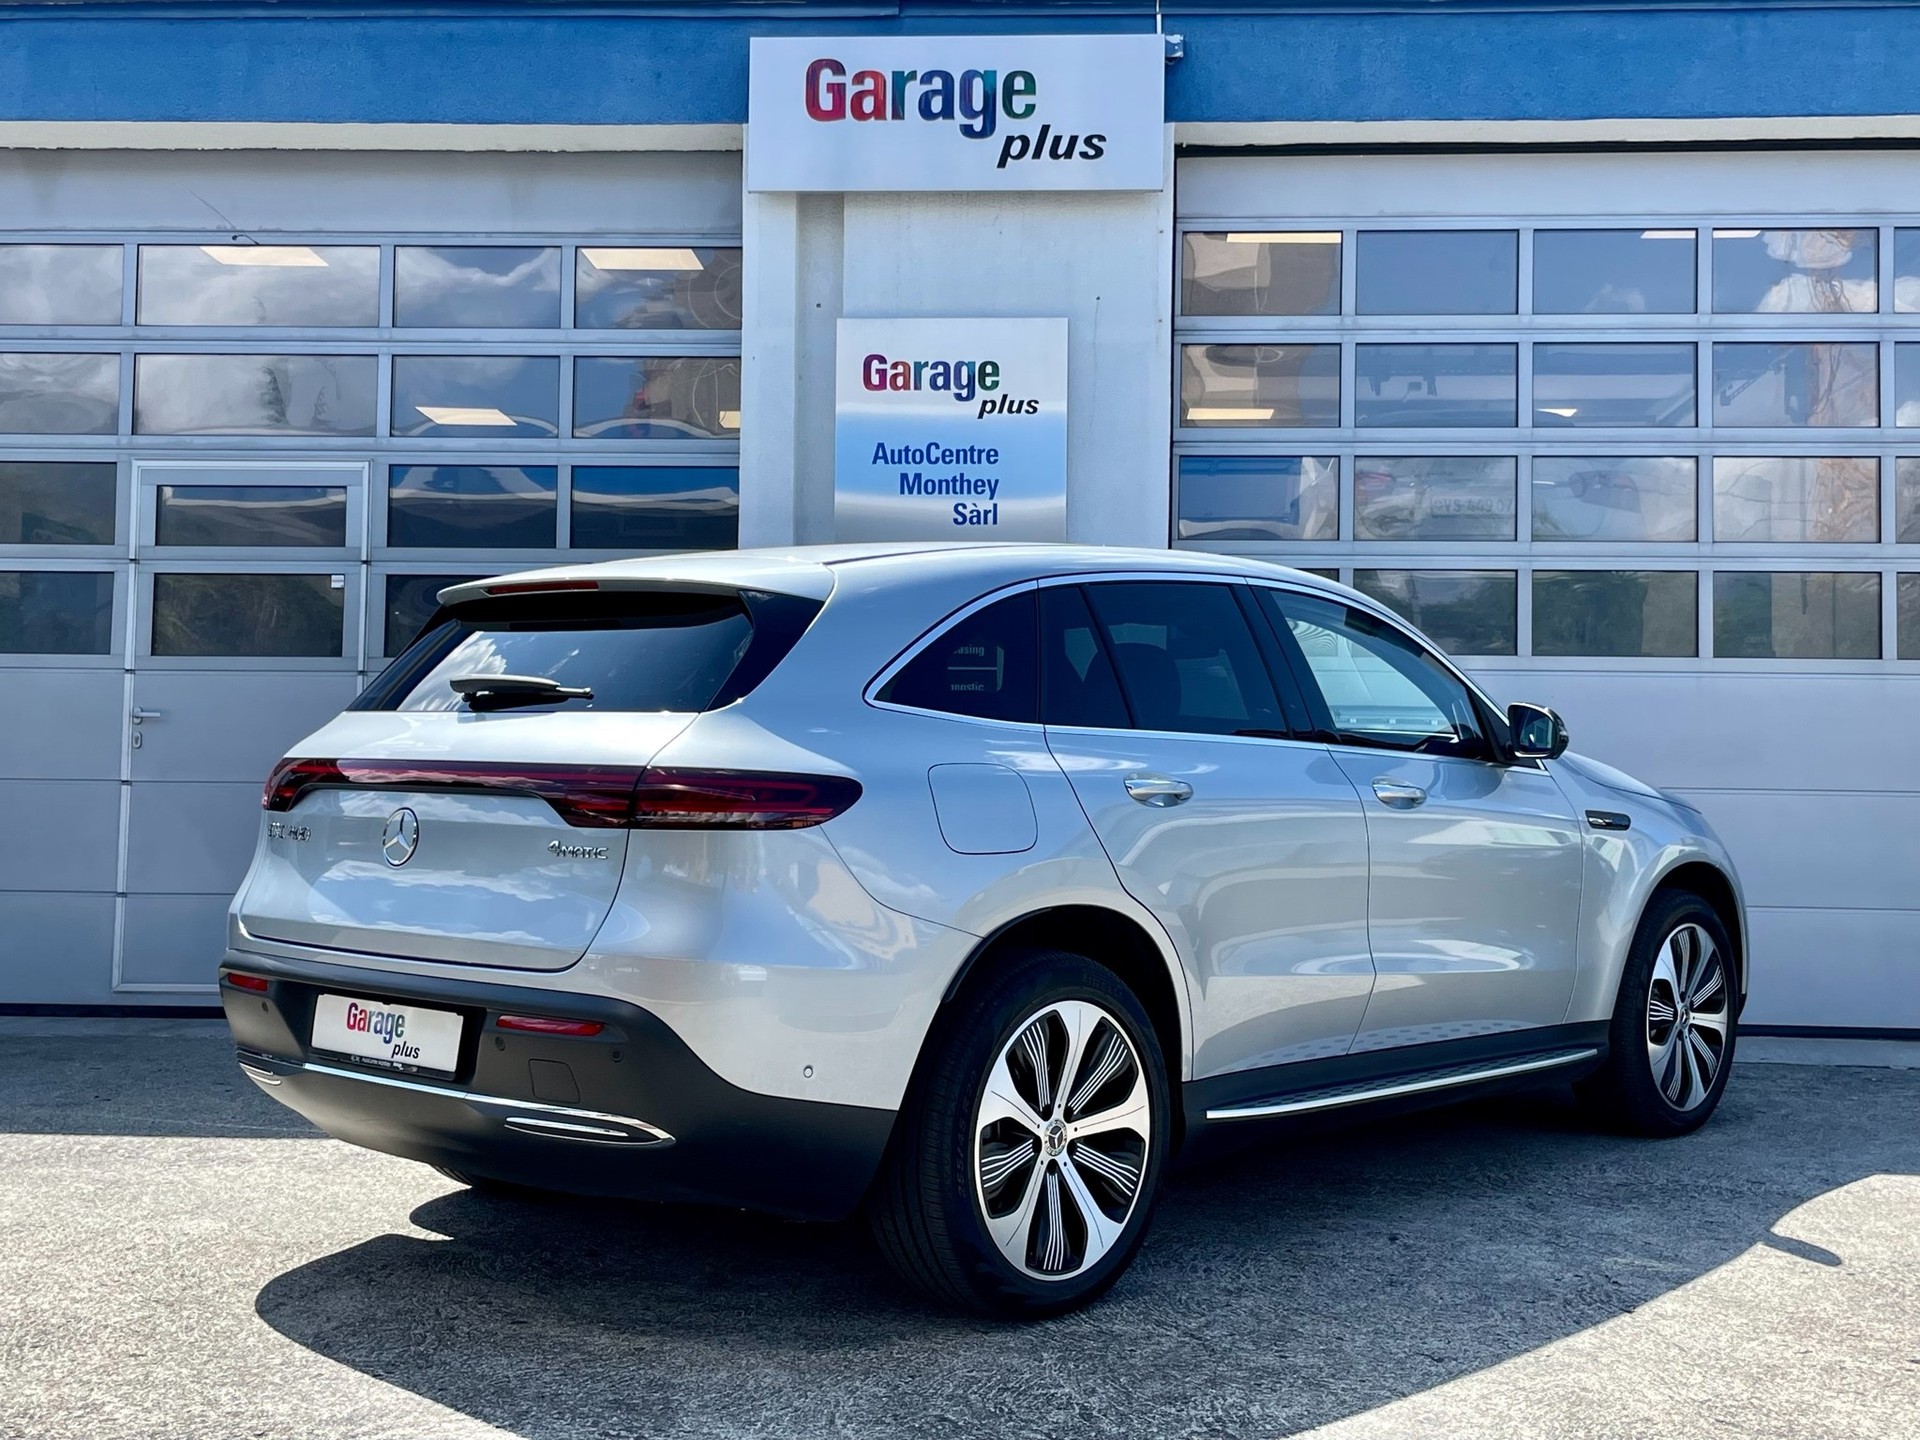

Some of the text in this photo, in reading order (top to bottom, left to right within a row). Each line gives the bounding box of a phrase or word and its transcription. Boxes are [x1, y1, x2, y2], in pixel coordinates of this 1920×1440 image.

[805, 58, 1037, 139] Garage
[996, 124, 1107, 169] plus
[862, 354, 1000, 402] Garage
[977, 394, 1040, 419] plus
[871, 442, 999, 465] AutoCentre
[899, 472, 1000, 501] Monthey
[952, 502, 999, 526] Sàrl
[547, 839, 609, 860] 4MATIC
[346, 1002, 406, 1044] Garage
[391, 1041, 420, 1060] plus
